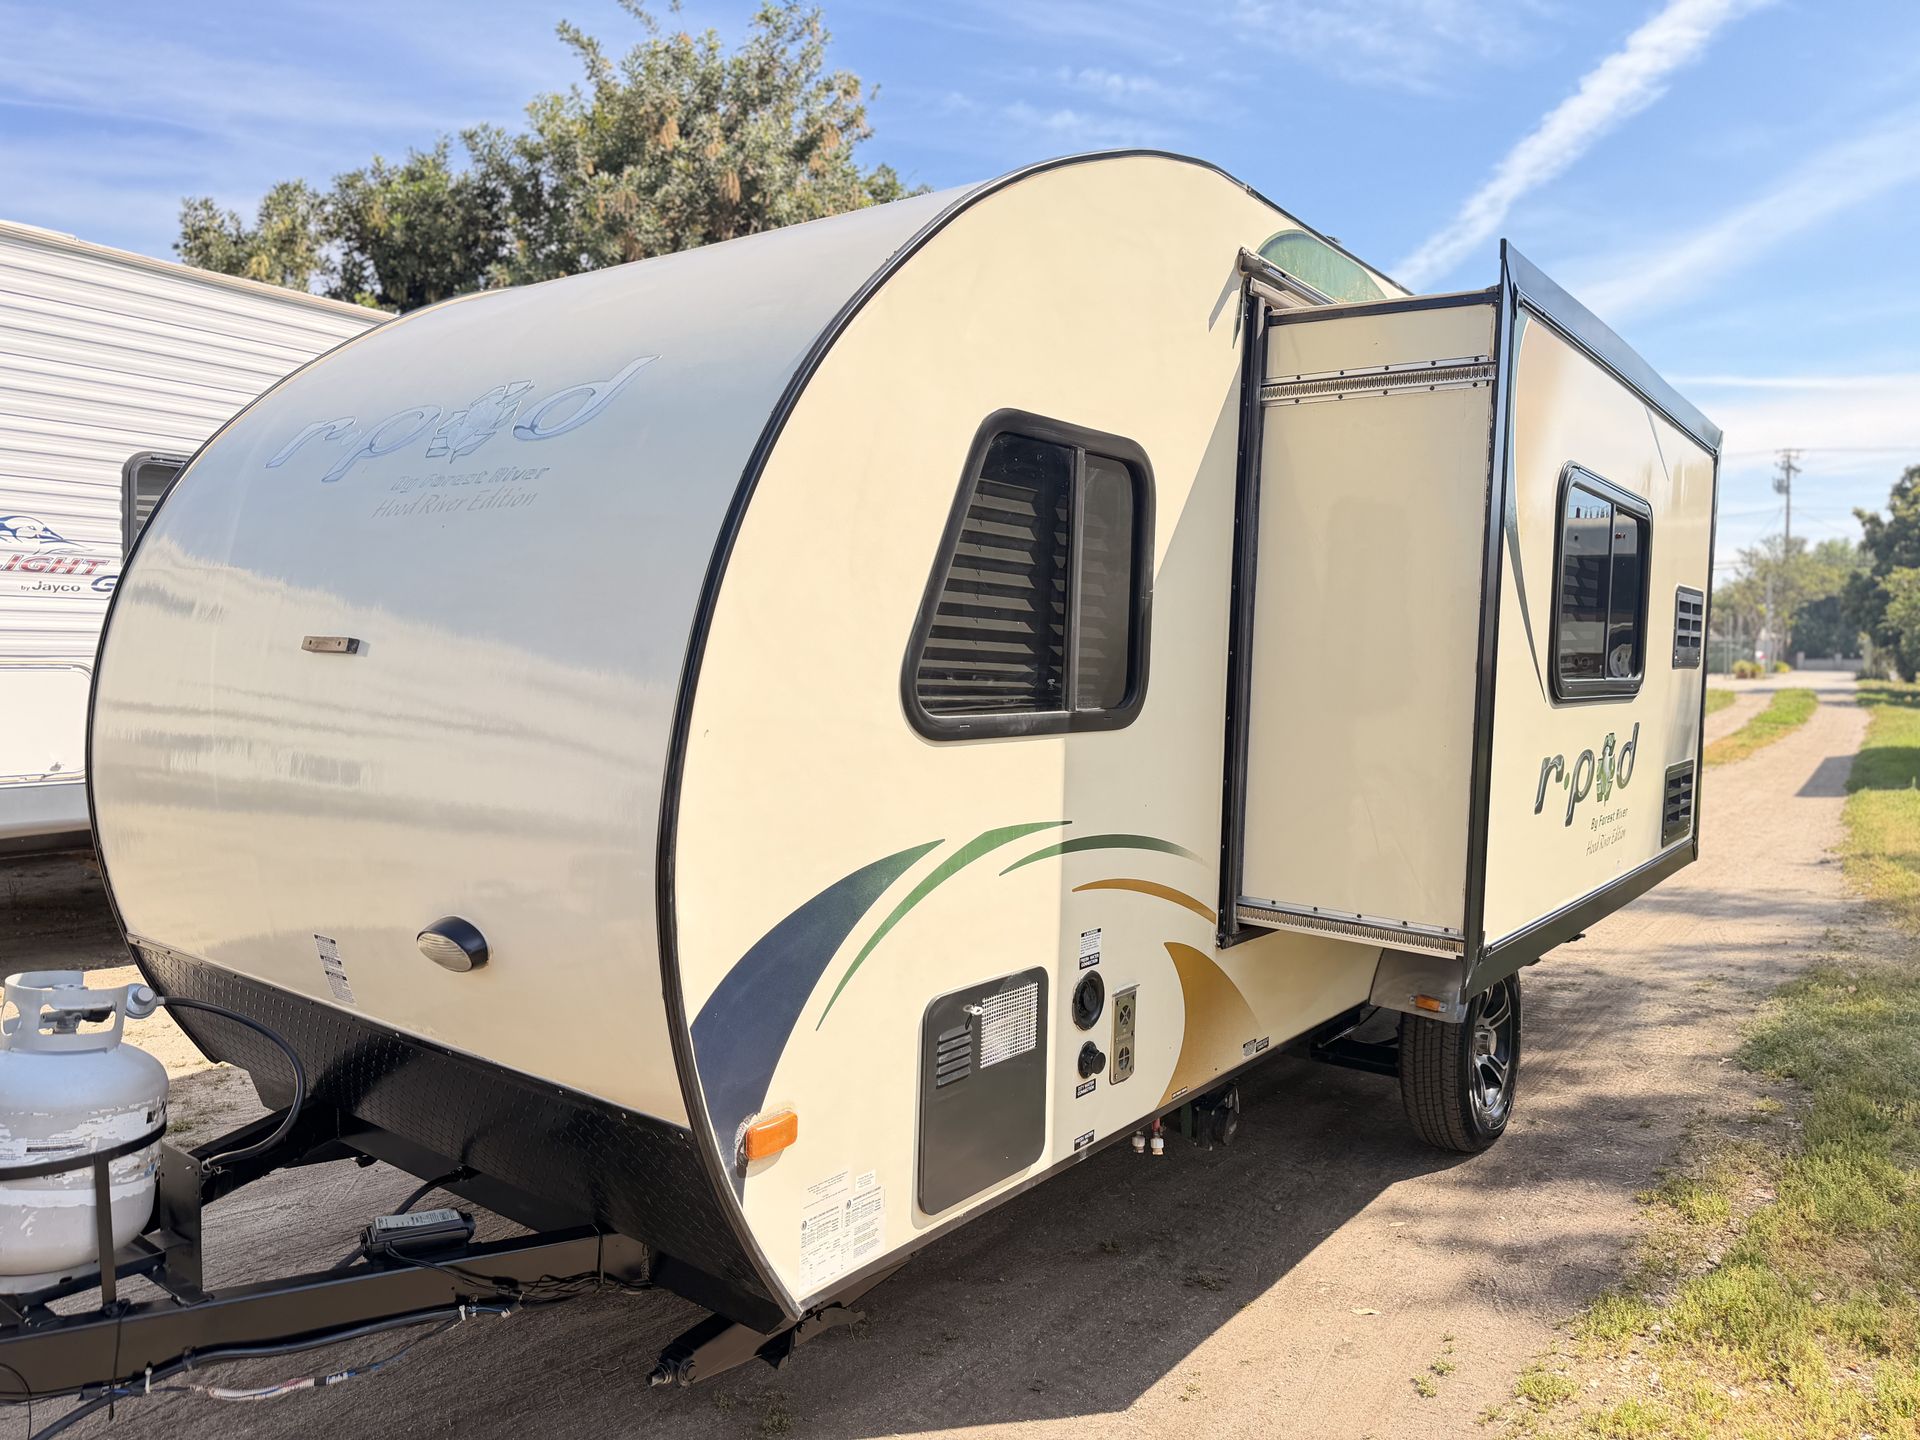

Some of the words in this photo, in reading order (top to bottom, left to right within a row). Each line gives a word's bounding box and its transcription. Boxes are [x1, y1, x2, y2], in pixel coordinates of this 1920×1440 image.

[489, 466, 550, 484] River
[419, 494, 468, 515] River
[467, 487, 538, 512] Edition
[0, 554, 110, 576] IGHT
[20, 584, 31, 592] by
[32, 580, 81, 593] Jayco
[1599, 812, 1615, 827] Forest
